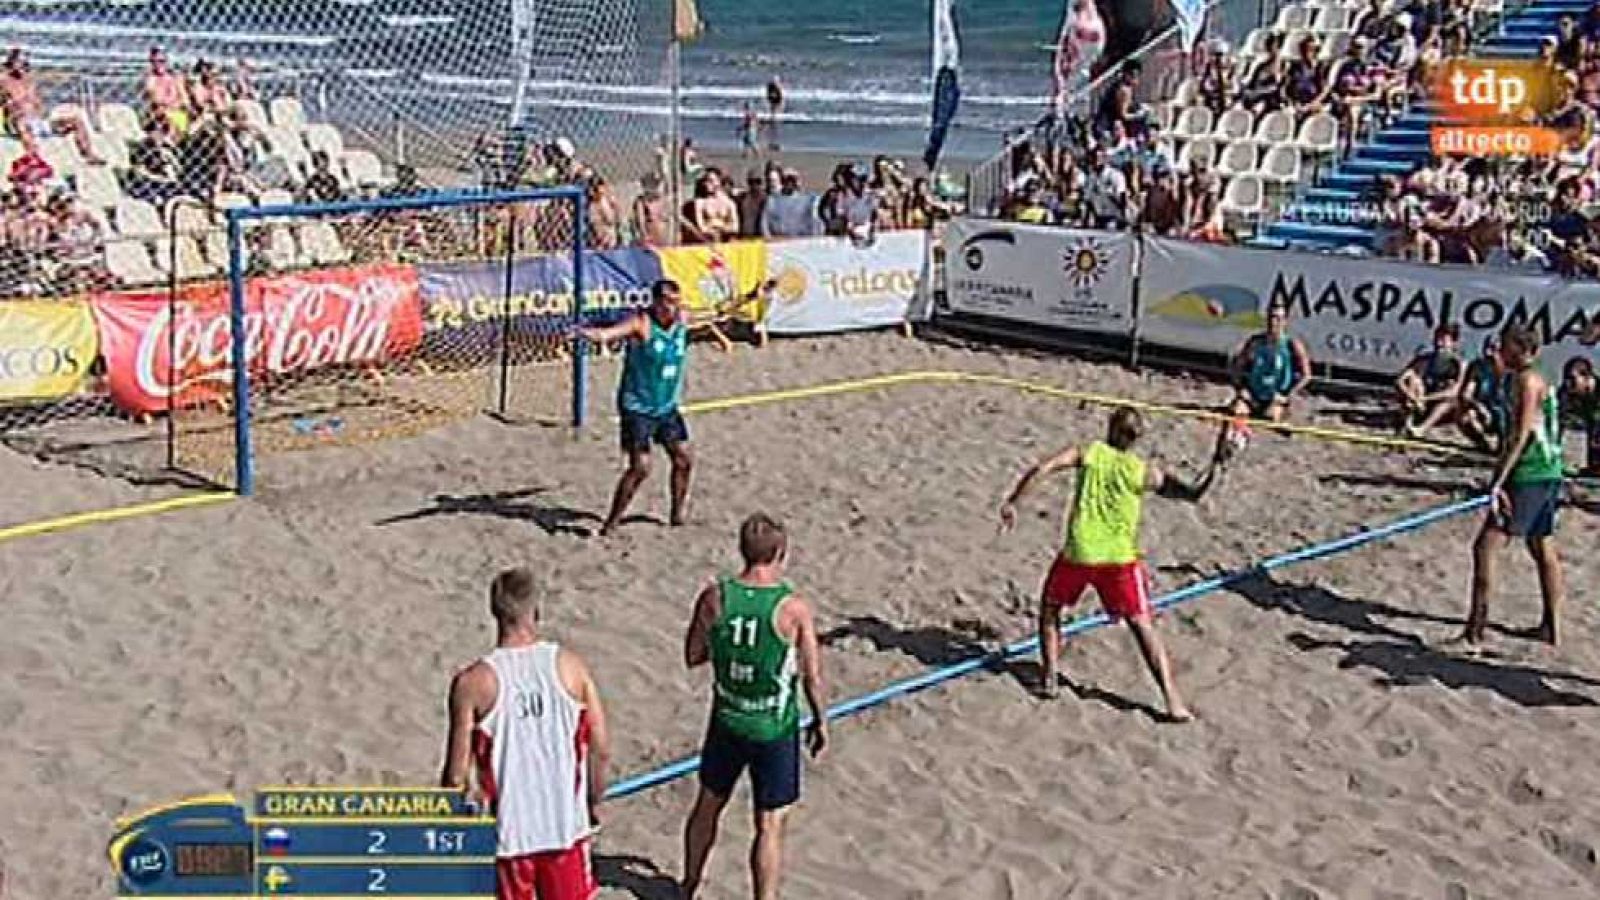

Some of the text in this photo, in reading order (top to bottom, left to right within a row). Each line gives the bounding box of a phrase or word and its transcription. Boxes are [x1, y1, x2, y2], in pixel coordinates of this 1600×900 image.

[1265, 270, 1600, 346] MASPALOMA
[1324, 331, 1400, 358] COSTA
[0, 345, 79, 378] COS
[729, 616, 758, 647] 11
